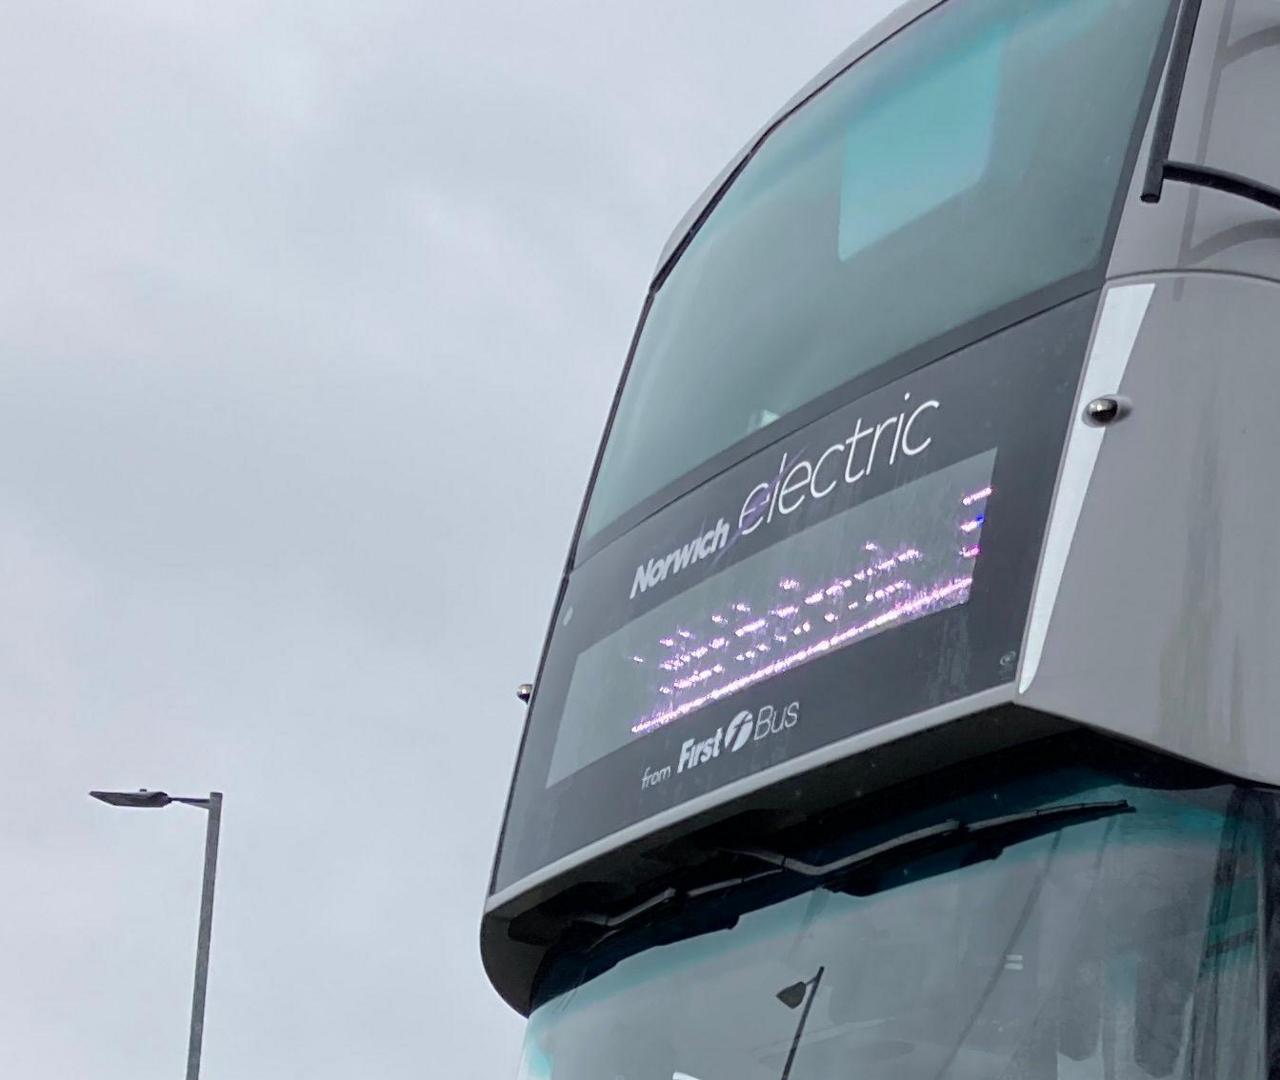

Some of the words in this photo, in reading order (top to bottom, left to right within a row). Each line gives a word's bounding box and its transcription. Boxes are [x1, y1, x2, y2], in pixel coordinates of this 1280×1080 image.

[629, 517, 731, 600] Norwich
[738, 392, 940, 535] electric
[641, 767, 672, 791] from
[676, 727, 724, 774] First
[754, 702, 800, 741] Bus
